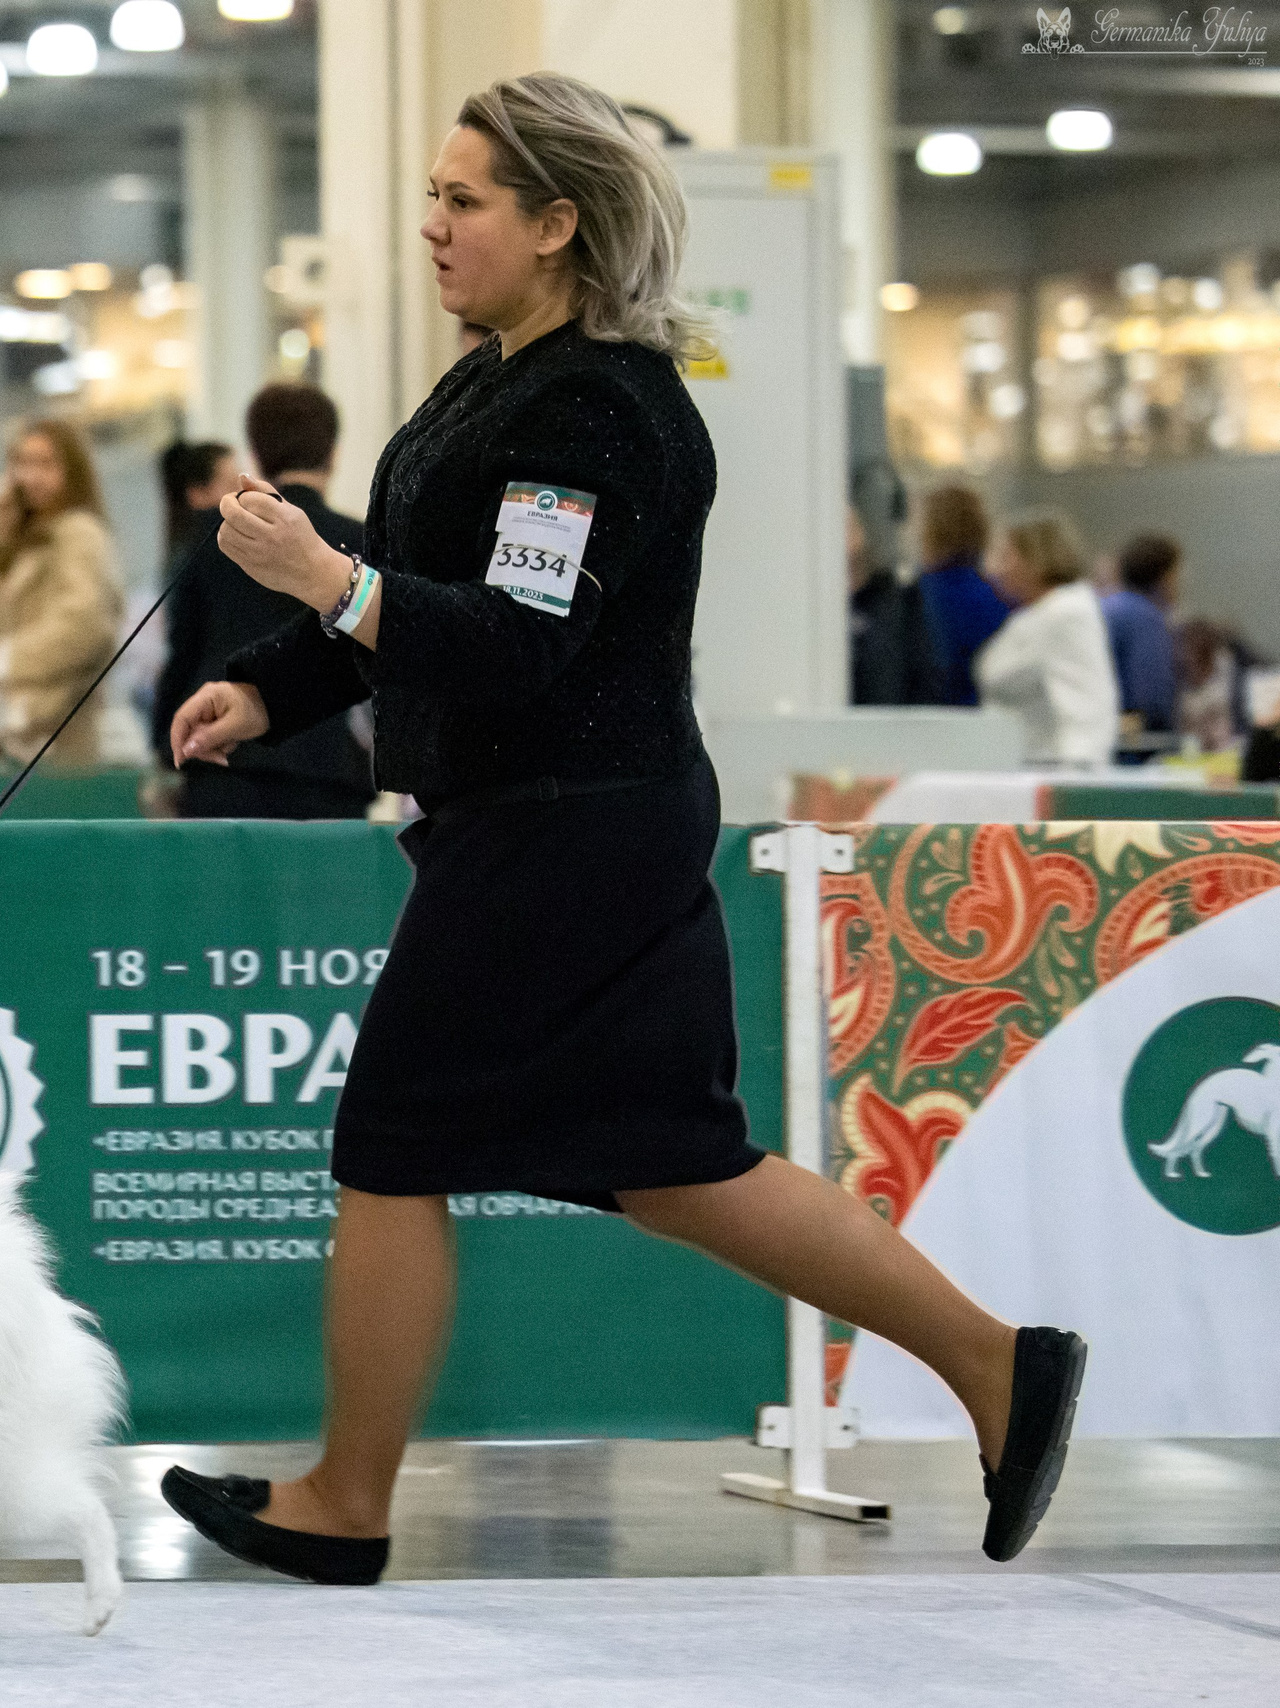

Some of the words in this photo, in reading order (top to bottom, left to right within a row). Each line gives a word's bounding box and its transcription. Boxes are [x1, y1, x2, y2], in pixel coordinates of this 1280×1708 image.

[497, 543, 567, 578] 3334
[90, 948, 146, 987] 18
[205, 948, 261, 987] 19
[90, 1012, 359, 1104] ЕВРА
[231, 1129, 320, 1150] КУБОК
[92, 1171, 257, 1193] ВСЕМИРНАЯ
[92, 1198, 210, 1222] ПОРОДЫ
[213, 1197, 341, 1221] СРЕДНЕА
[232, 1239, 322, 1260] КУБОК
